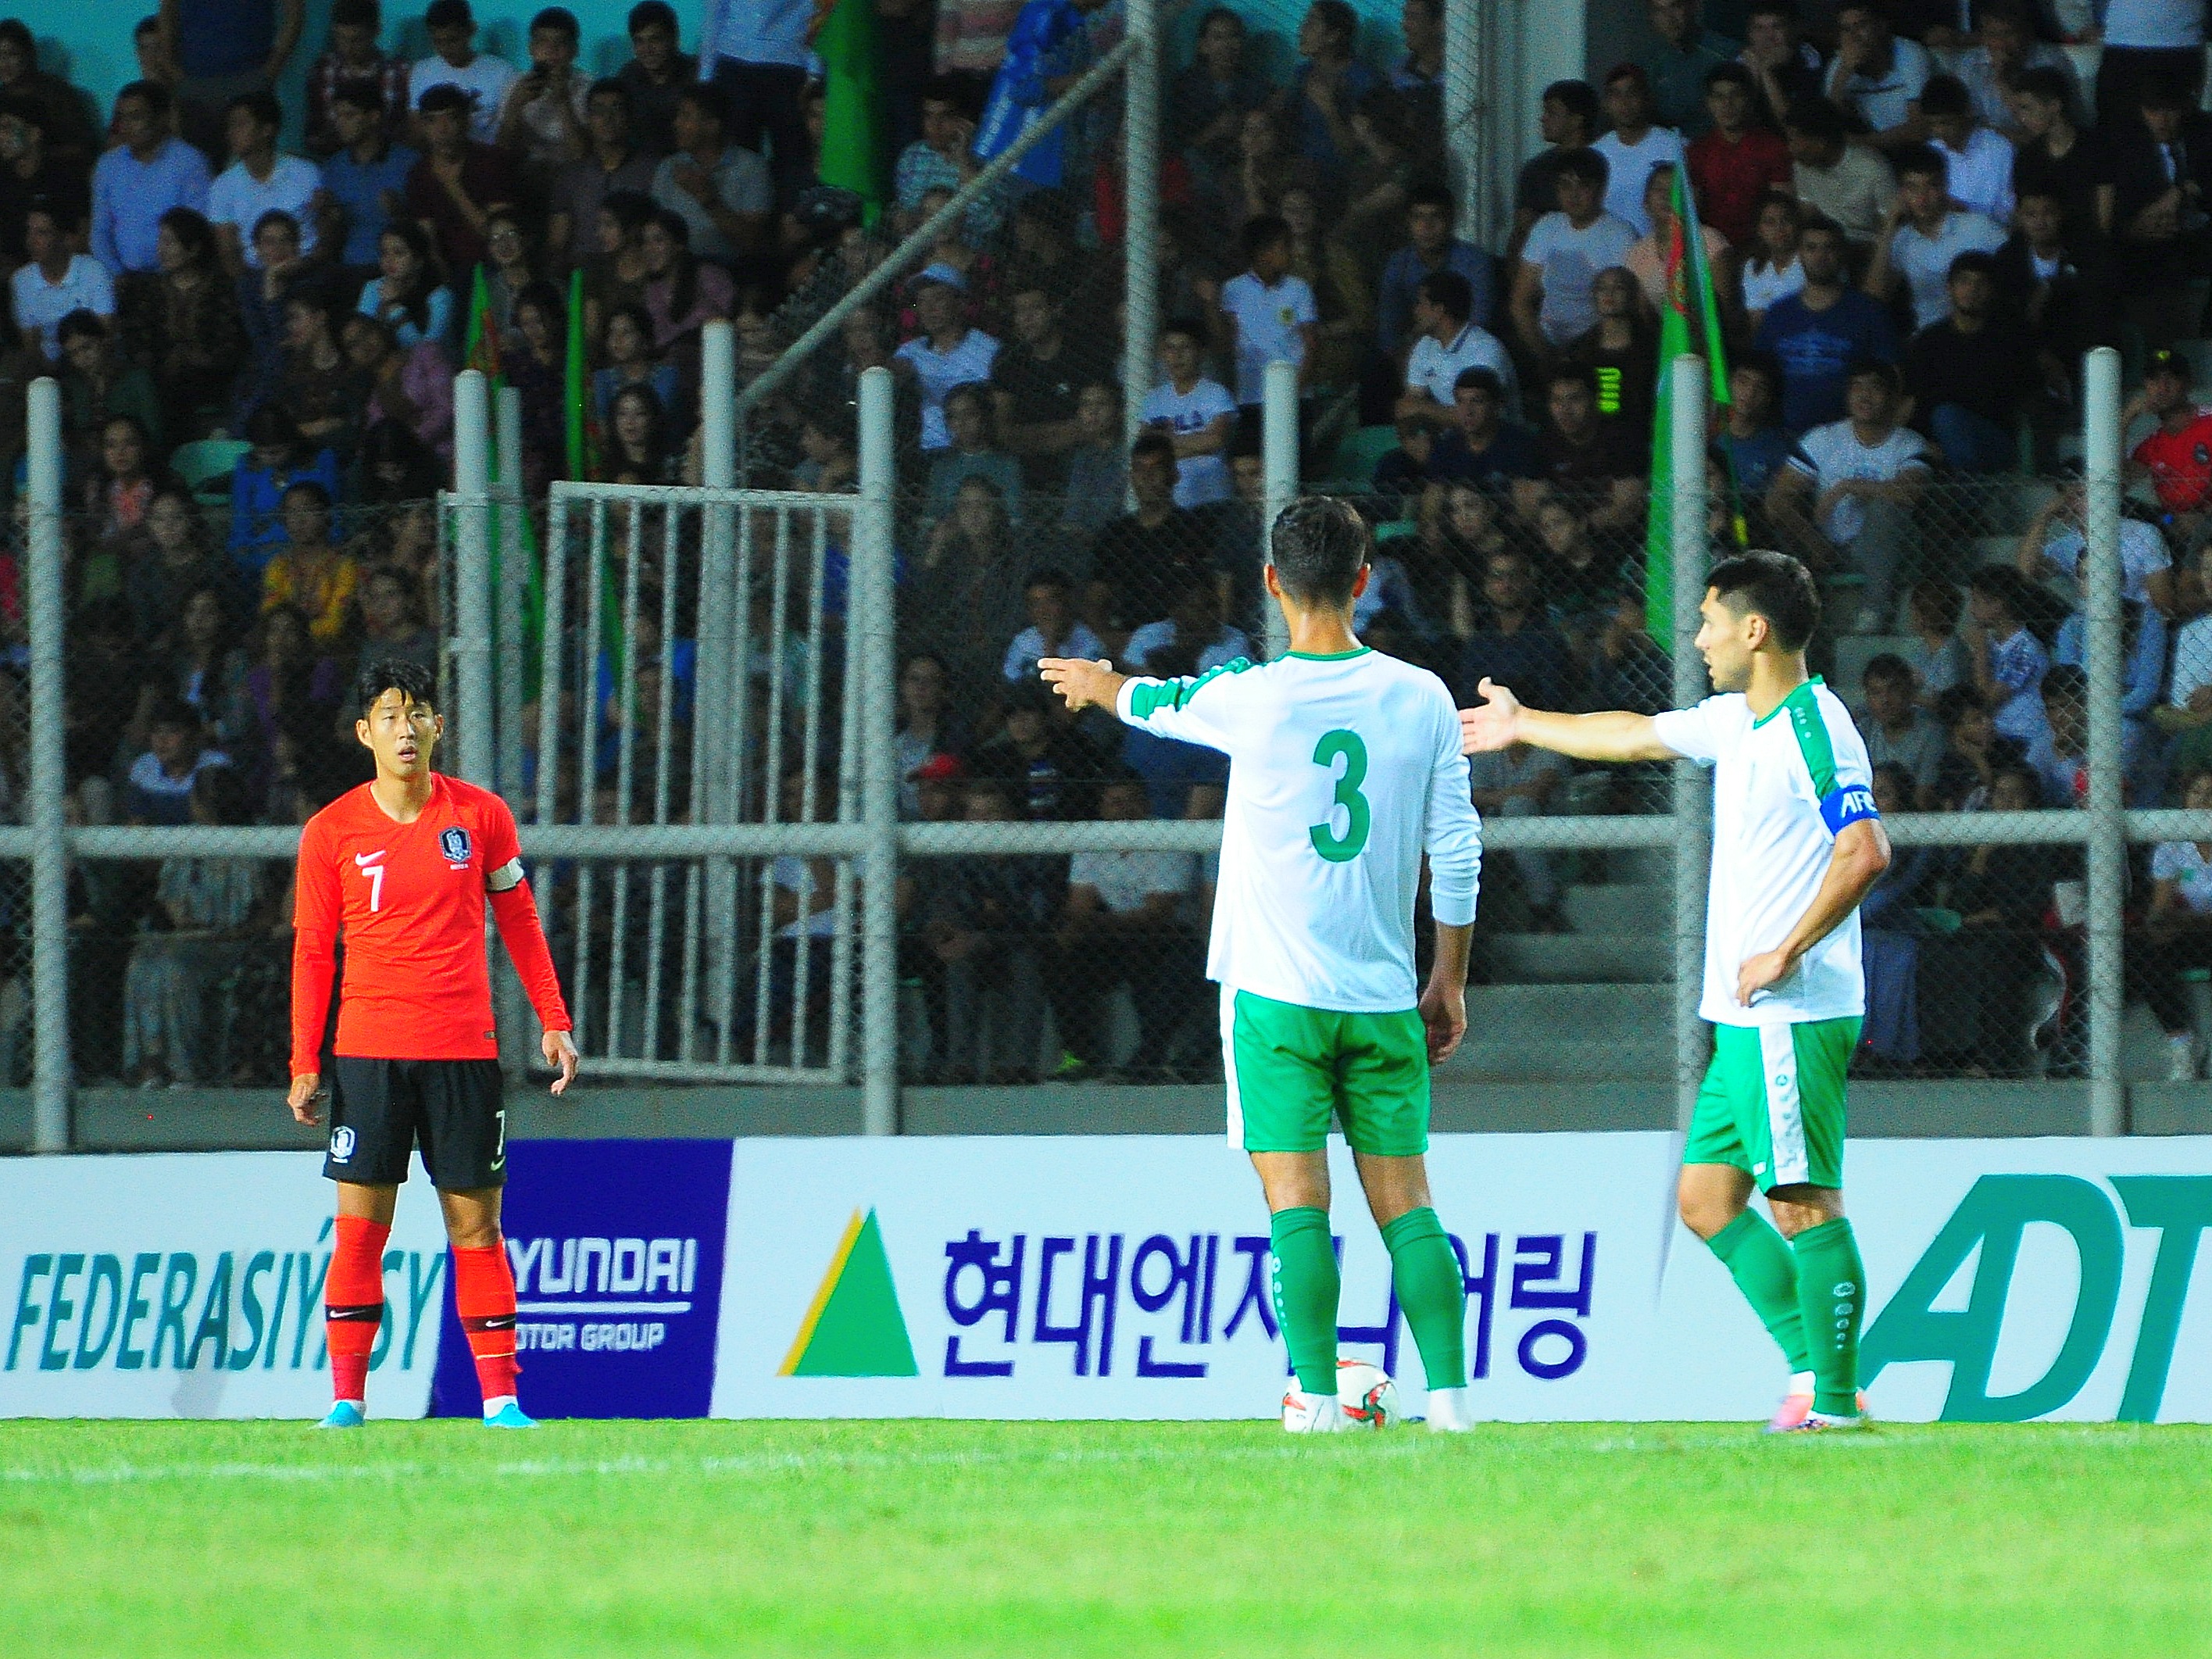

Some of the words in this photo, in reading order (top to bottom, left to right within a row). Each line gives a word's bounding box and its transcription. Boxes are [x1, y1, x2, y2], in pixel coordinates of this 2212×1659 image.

[1310, 729, 1370, 863] 3
[362, 865, 384, 912] 7
[506, 1237, 697, 1293] YUNDAI
[5, 1216, 447, 1371] FEDERASIÝSY
[516, 1323, 576, 1350] OTOR
[581, 1323, 665, 1351] GROUP
